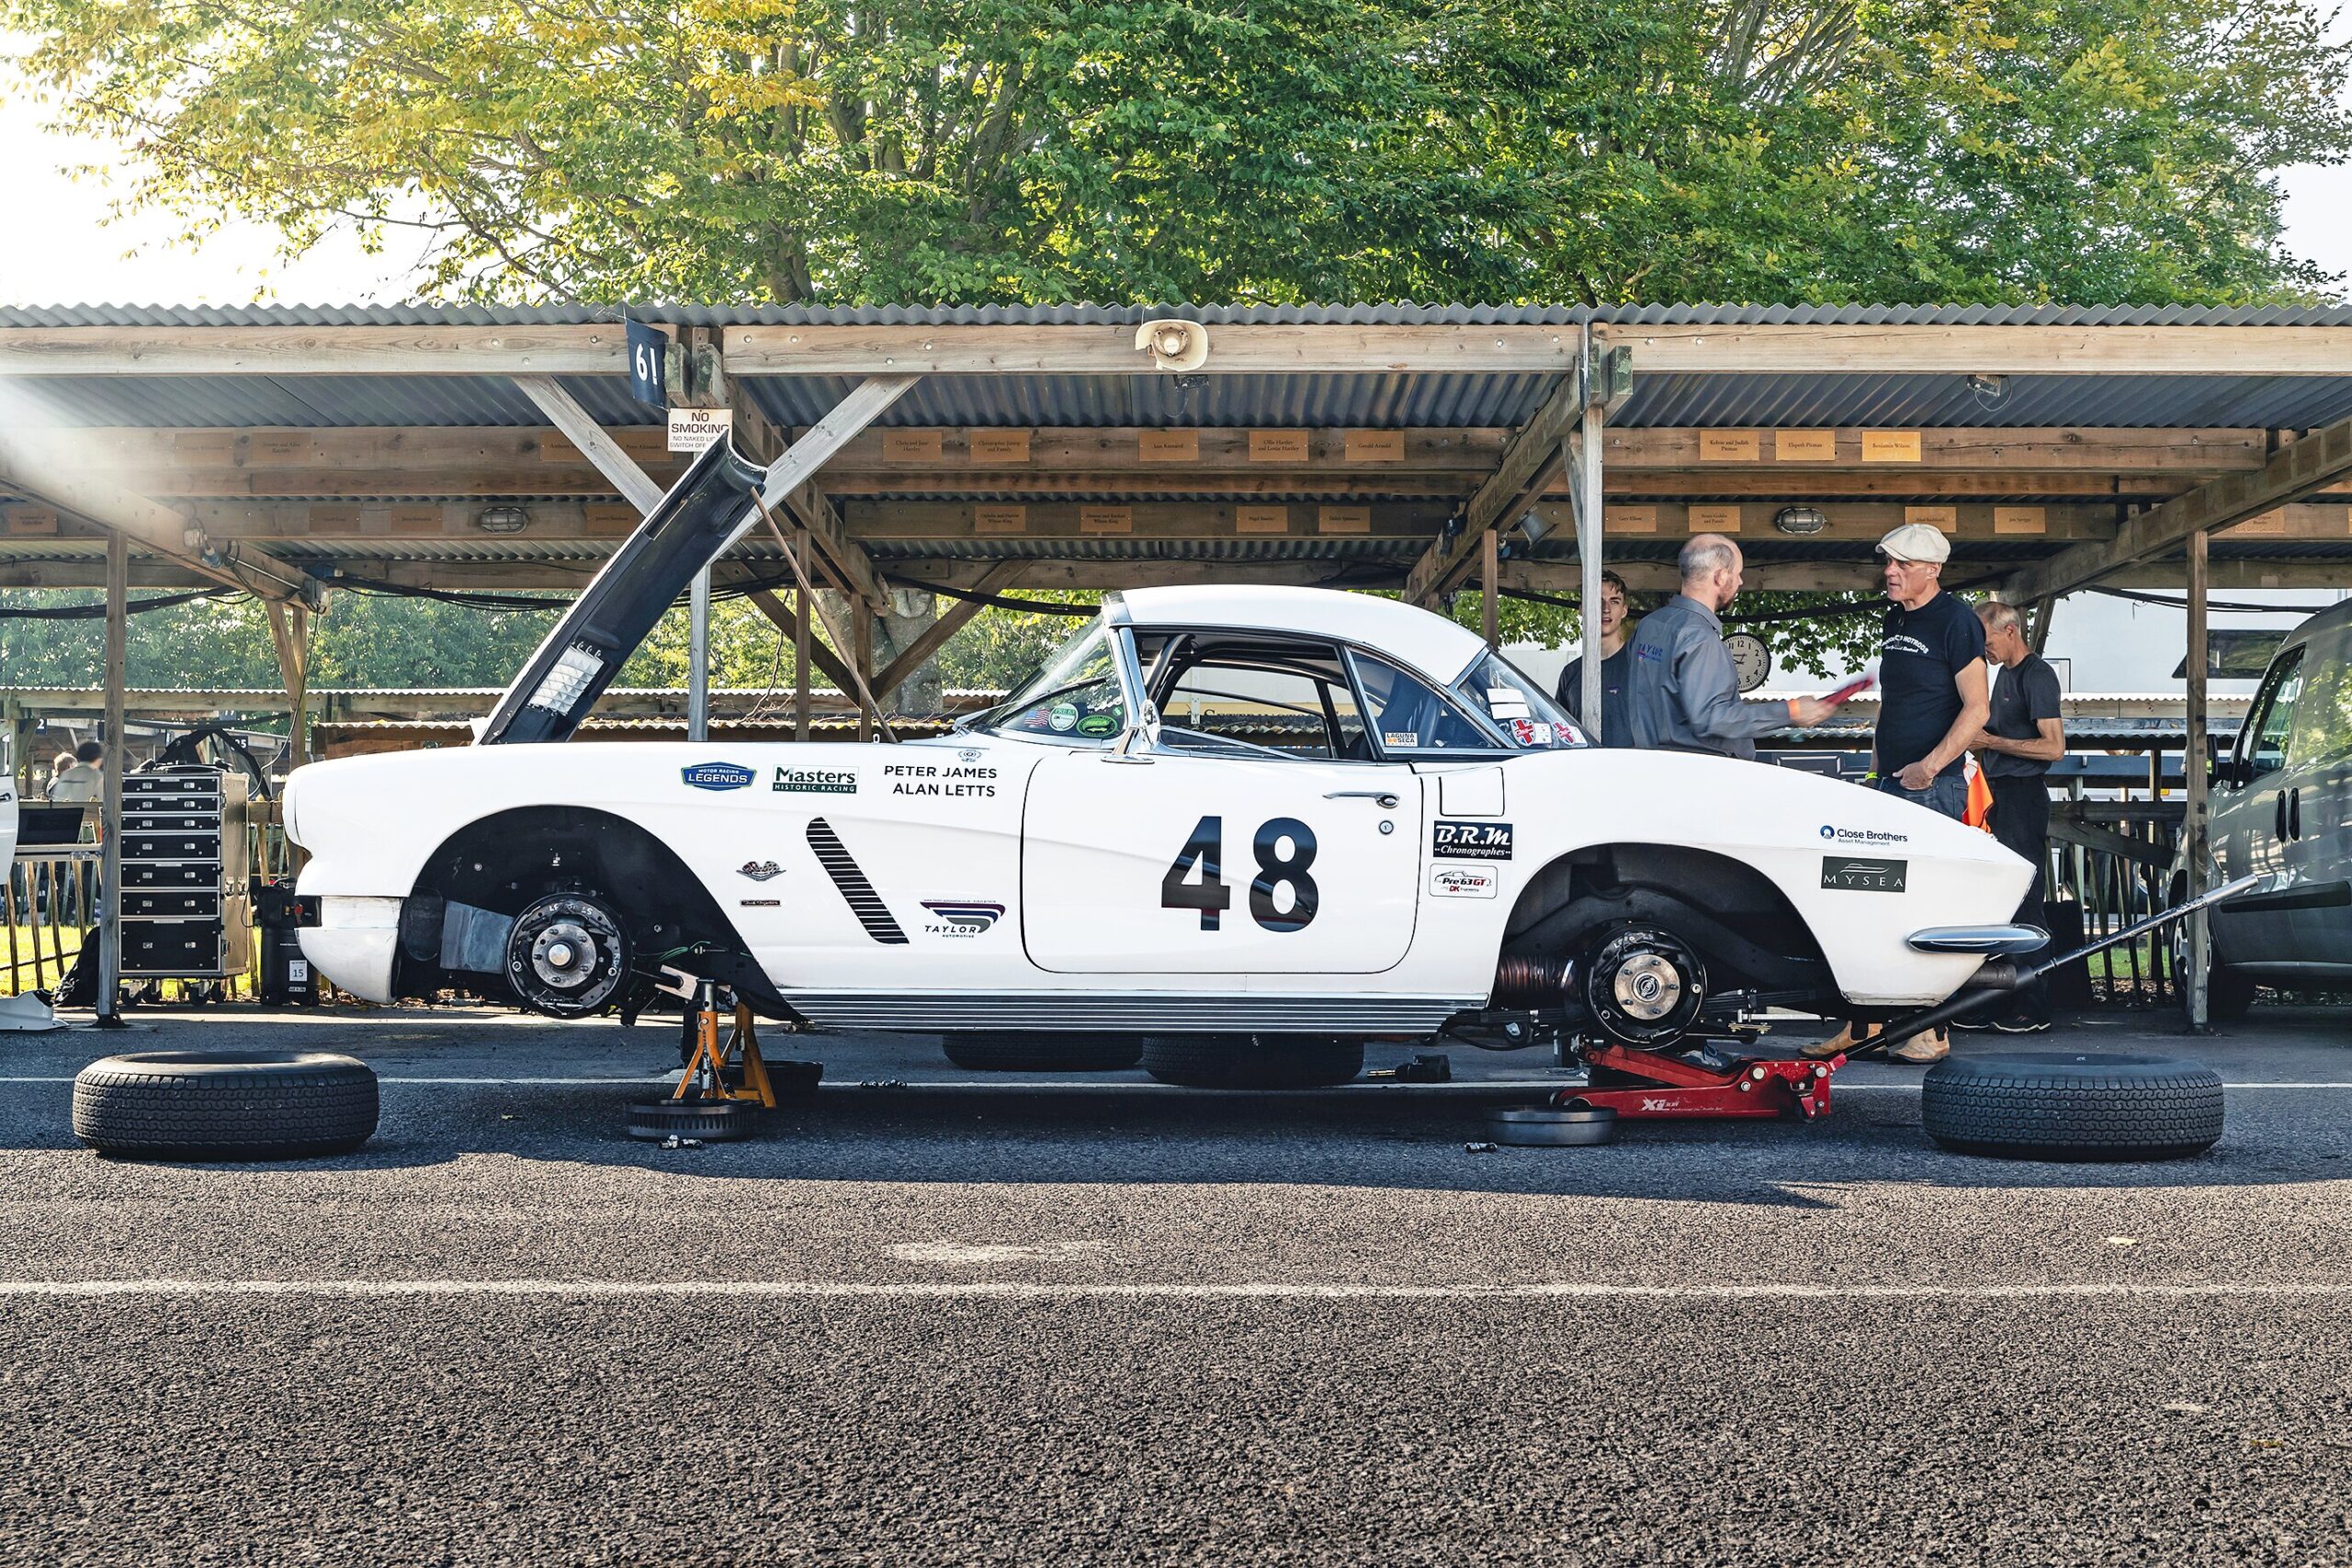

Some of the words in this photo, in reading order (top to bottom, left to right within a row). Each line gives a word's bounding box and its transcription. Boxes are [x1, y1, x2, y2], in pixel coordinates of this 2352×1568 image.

[636, 343, 658, 386] 61
[691, 412, 709, 422] NO
[775, 766, 855, 784] Masters
[884, 765, 937, 777] PETER
[942, 767, 998, 778] JAMES
[688, 773, 748, 784] LEGENDS
[820, 784, 855, 793] RACING
[893, 783, 939, 795] ALAN
[945, 784, 996, 797] LETTS
[1837, 829, 1864, 839] Close
[1866, 830, 1908, 842] Brothers
[1441, 845, 1506, 857] Chronographes
[1161, 816, 1319, 933] 48
[1824, 874, 1904, 887] MYSEA
[293, 969, 304, 977] 15
